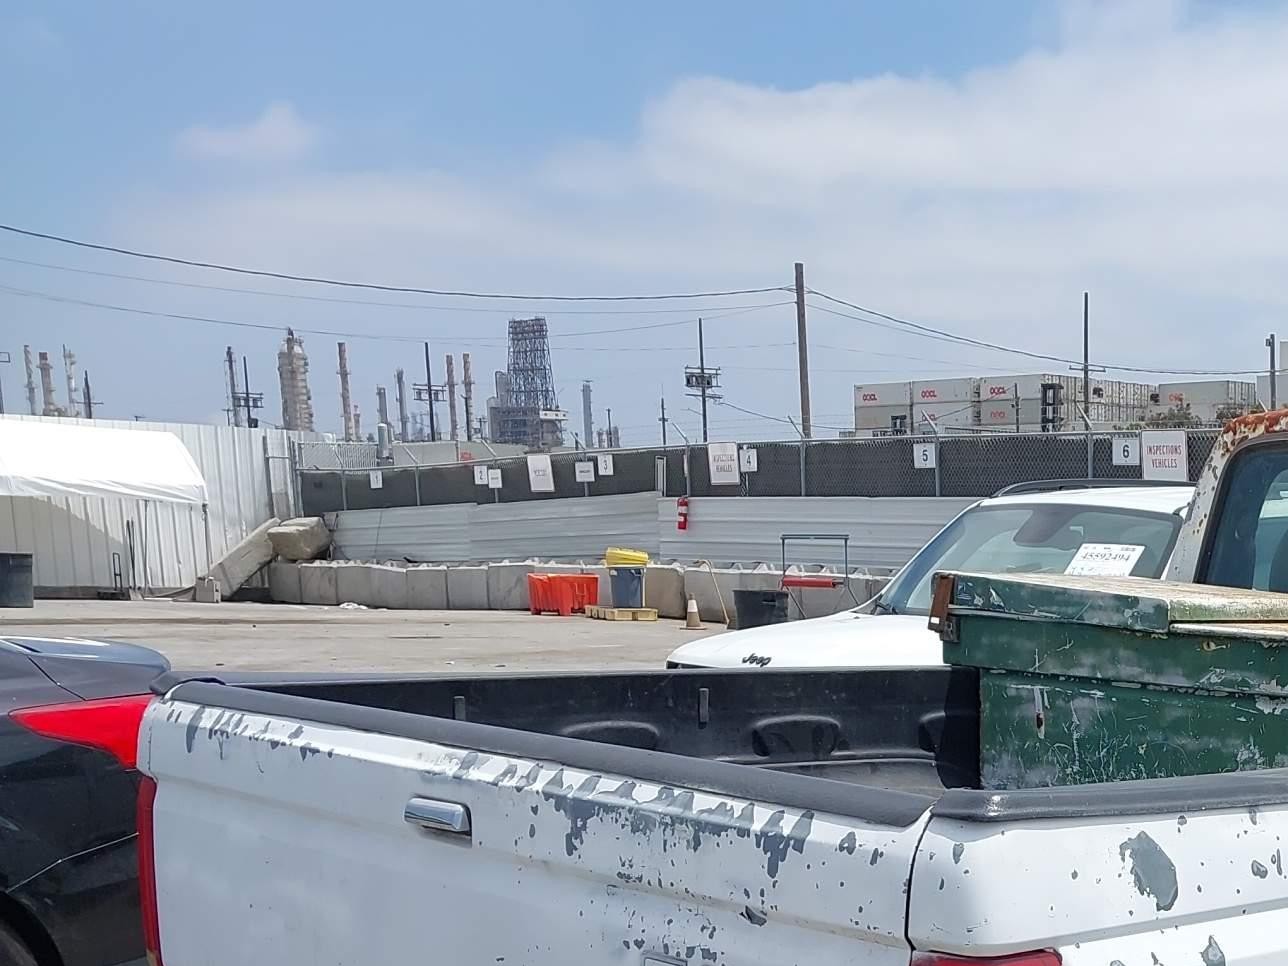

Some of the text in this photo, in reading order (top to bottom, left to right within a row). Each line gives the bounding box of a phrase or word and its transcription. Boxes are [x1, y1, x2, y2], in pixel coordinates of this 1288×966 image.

[922, 449, 929, 462] 5
[1122, 444, 1130, 459] 6
[1151, 458, 1178, 469] VEHICLES
[741, 652, 772, 668] Jeep
